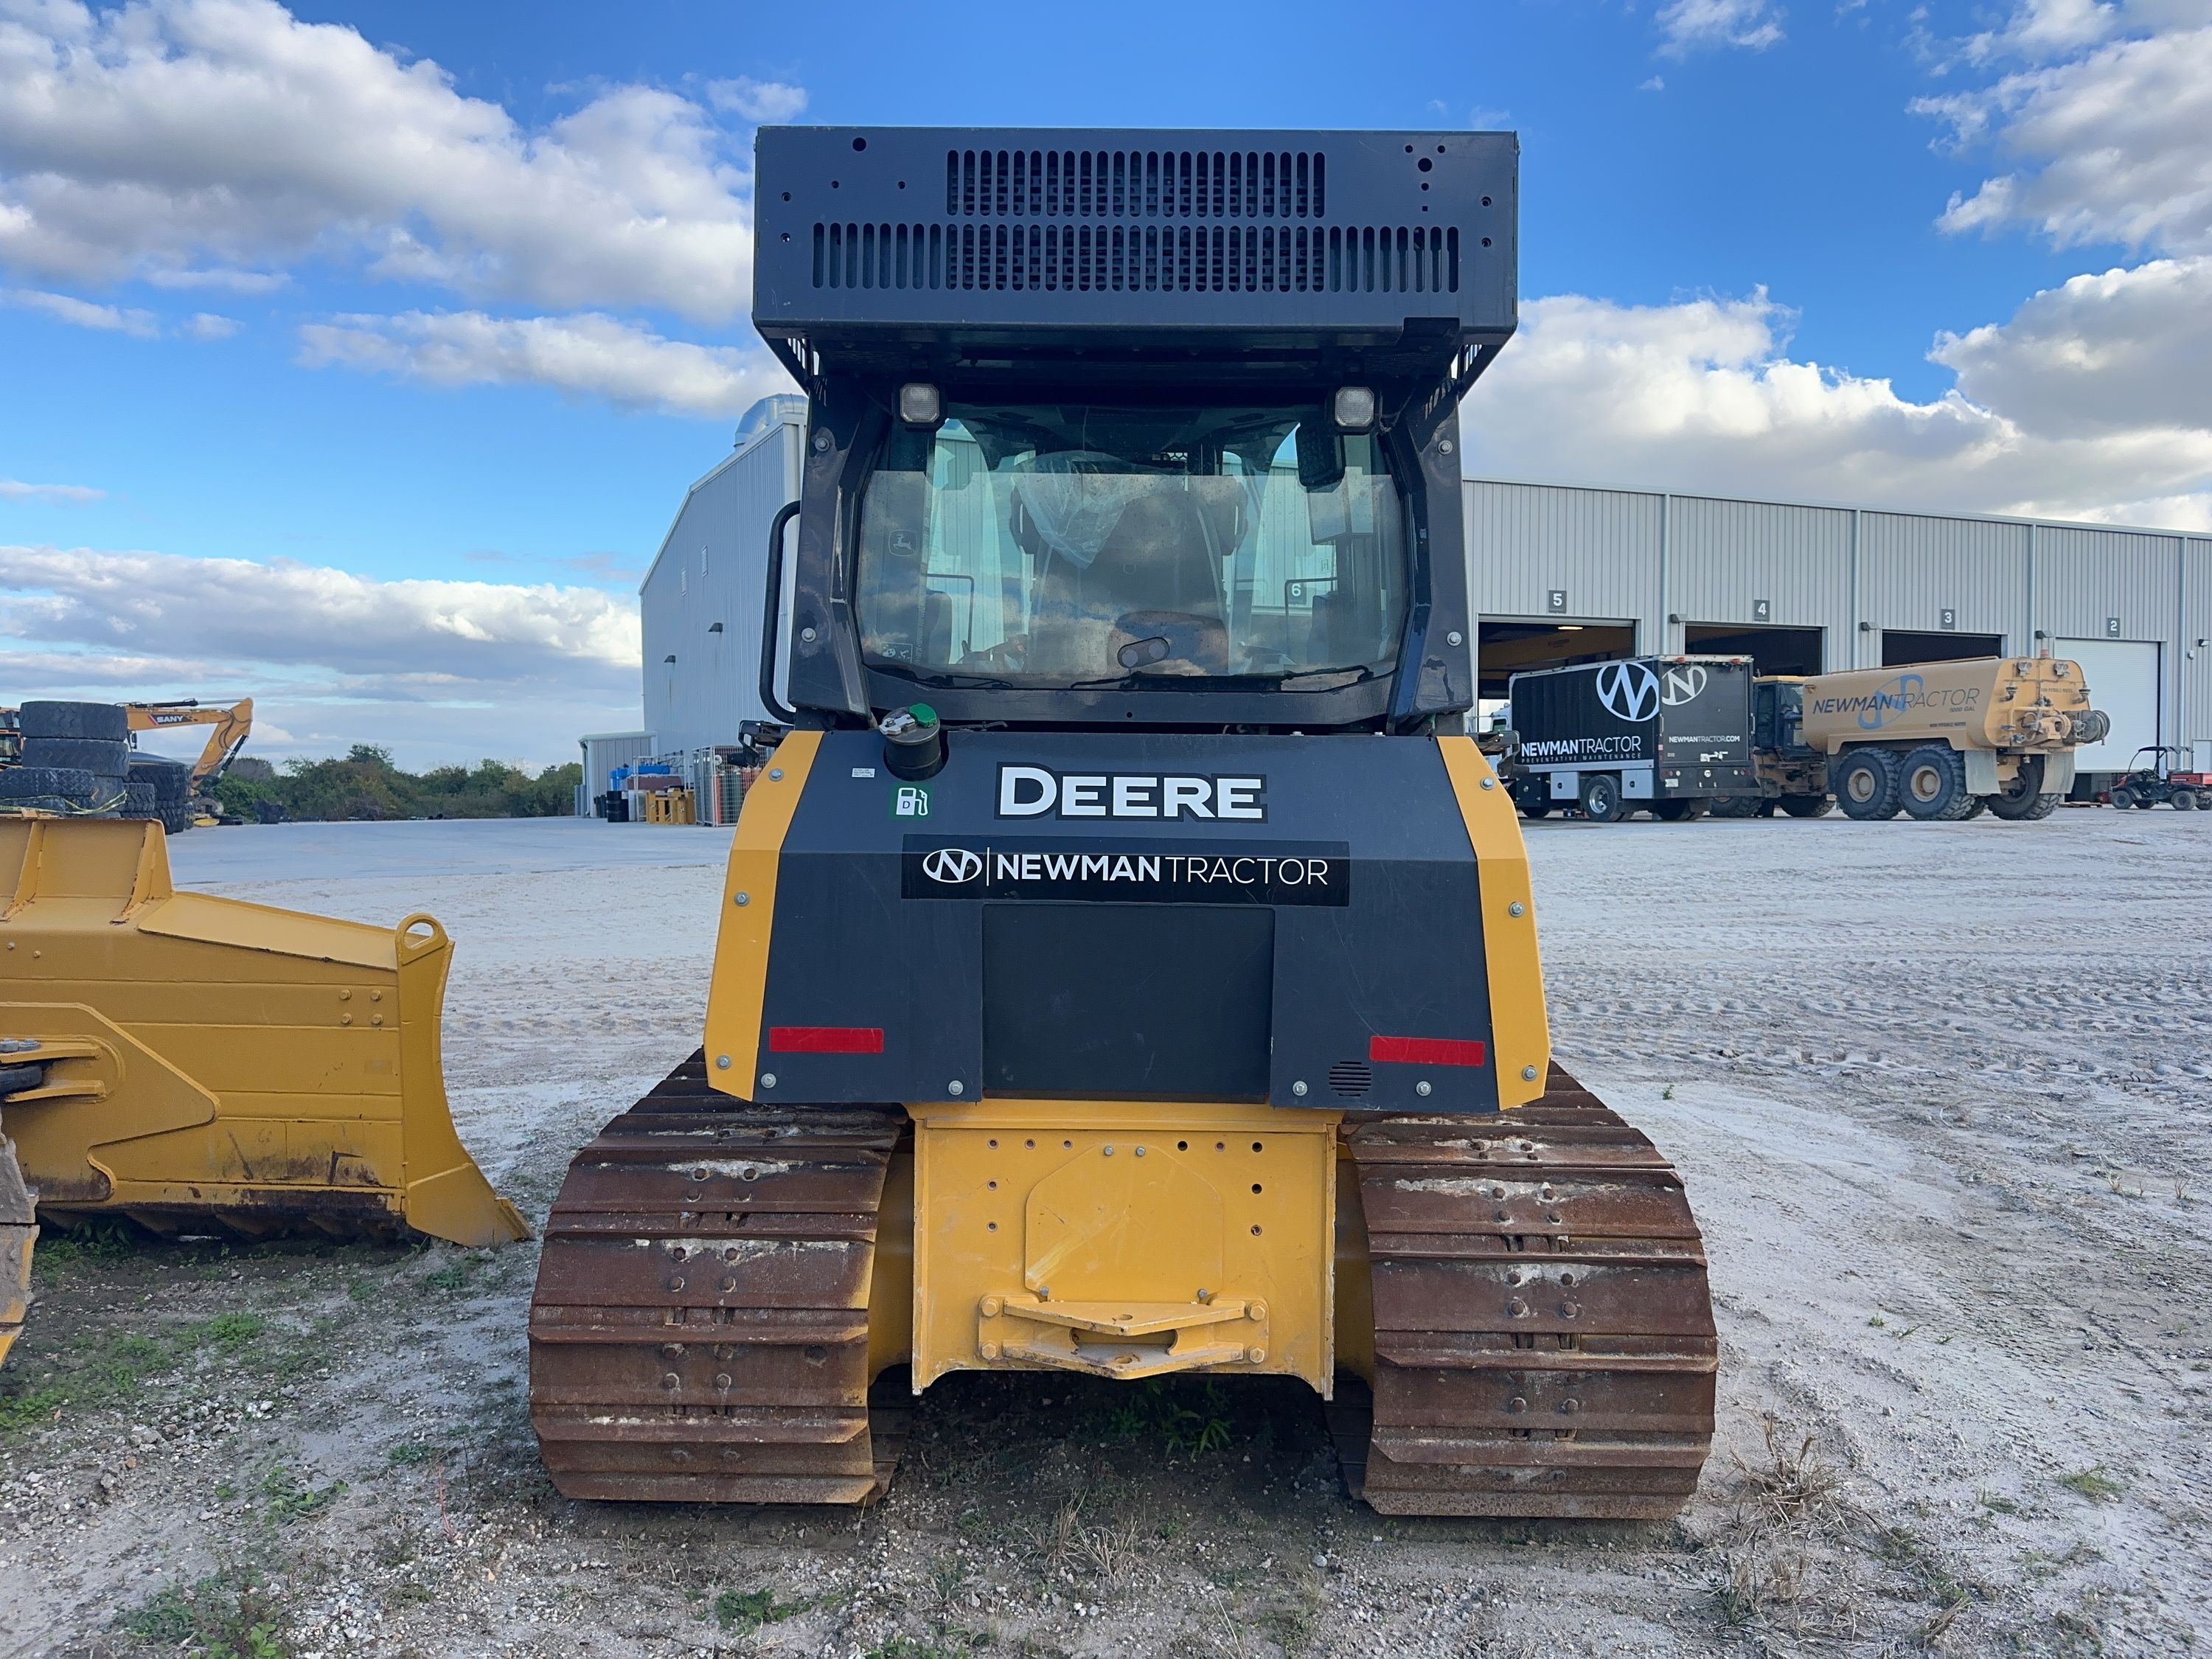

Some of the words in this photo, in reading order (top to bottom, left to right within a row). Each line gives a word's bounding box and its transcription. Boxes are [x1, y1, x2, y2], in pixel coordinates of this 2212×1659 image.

[1291, 583, 1301, 597] 6
[1553, 593, 1562, 607] 5
[1758, 602, 1767, 615] 4
[1944, 611, 1952, 624] 3
[2110, 620, 2118, 631] 2
[1669, 735, 1740, 743] NEWMANTRACTOR.COM
[1521, 755, 1577, 764] PREVENTATIVE
[1582, 752, 1641, 761] MAINTENANCE
[1000, 767, 1262, 818] DEERE
[902, 801, 910, 809] D
